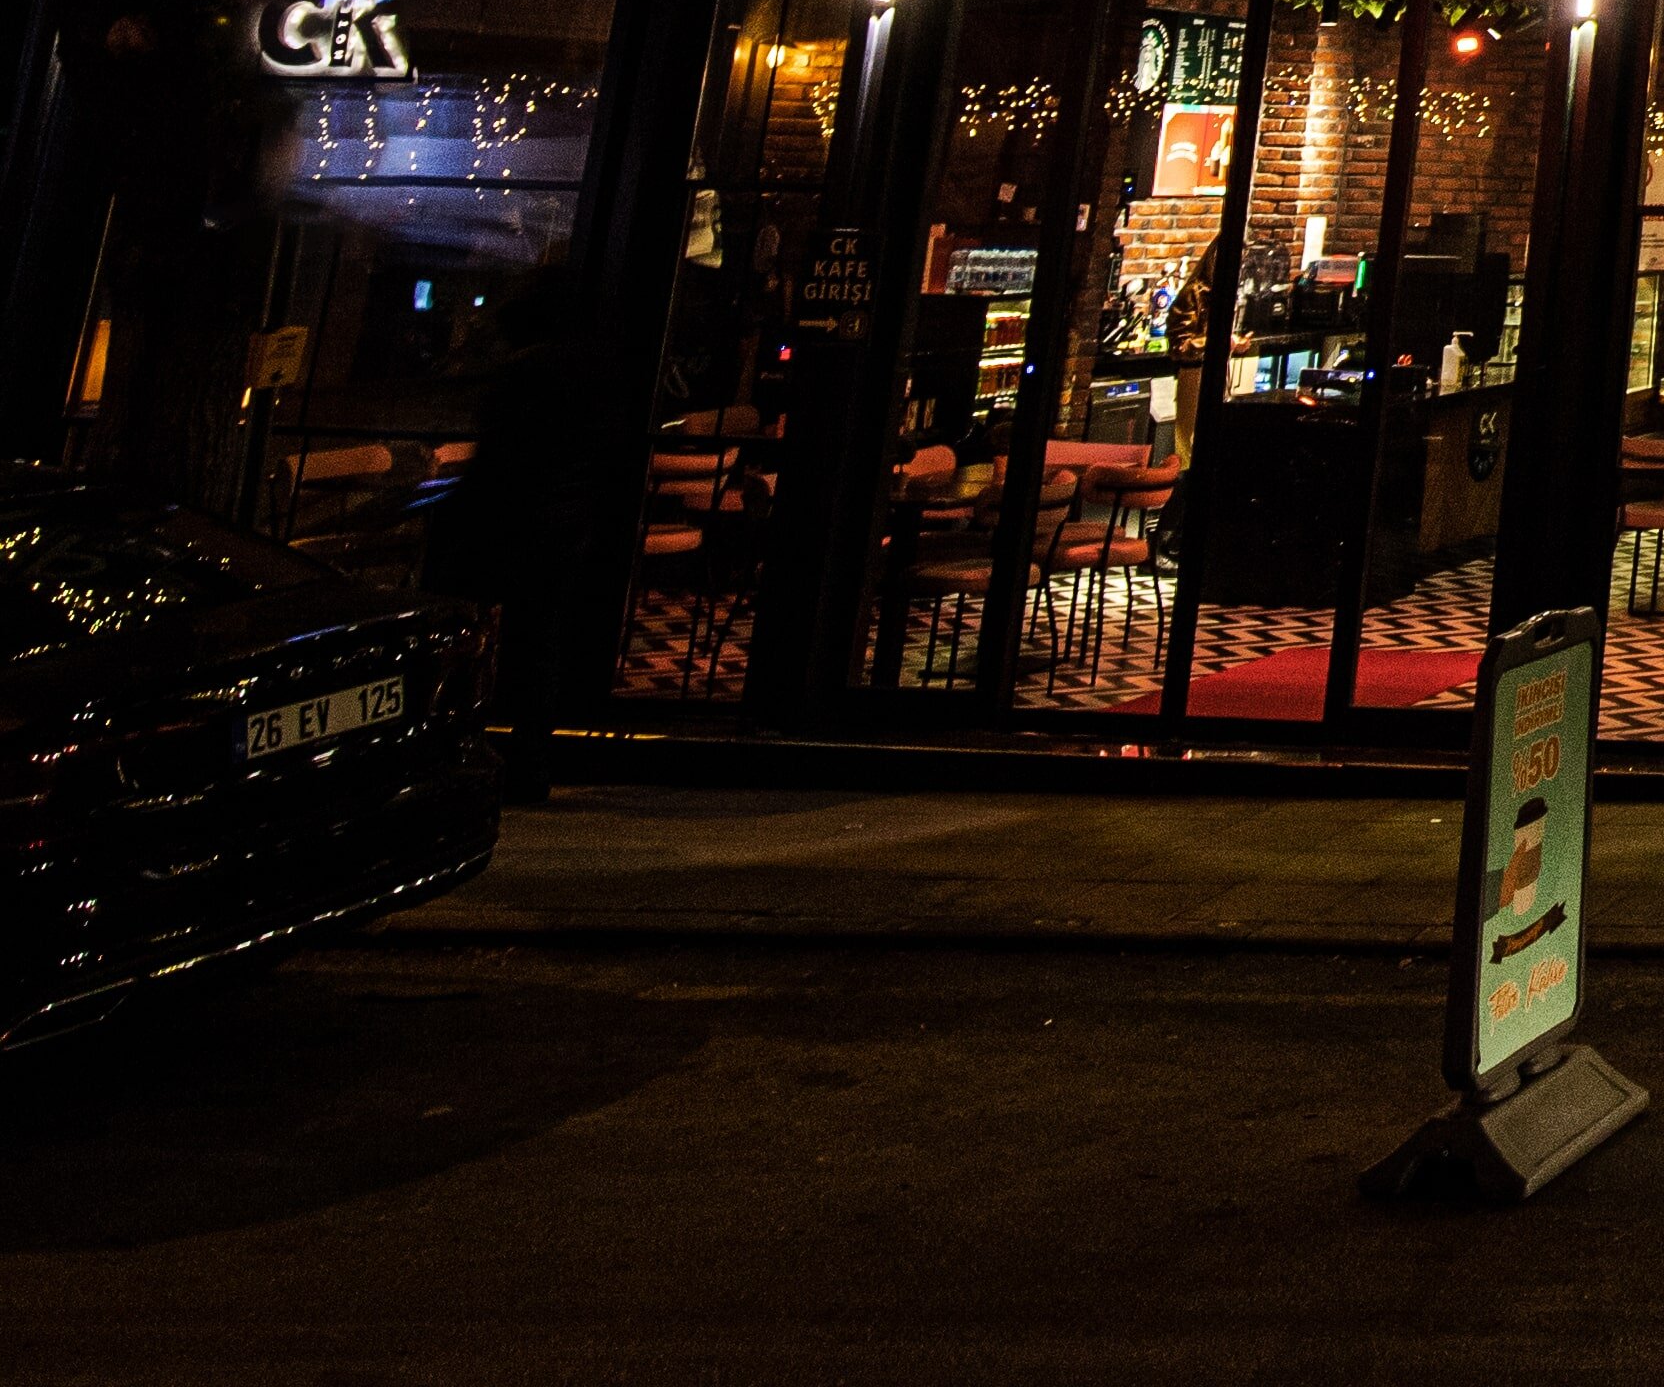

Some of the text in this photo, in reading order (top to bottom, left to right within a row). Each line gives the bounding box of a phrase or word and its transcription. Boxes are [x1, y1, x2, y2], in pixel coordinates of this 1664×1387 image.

[830, 237, 859, 256] CK
[813, 259, 871, 278] KAFE
[249, 680, 401, 754] 26 EV 125
